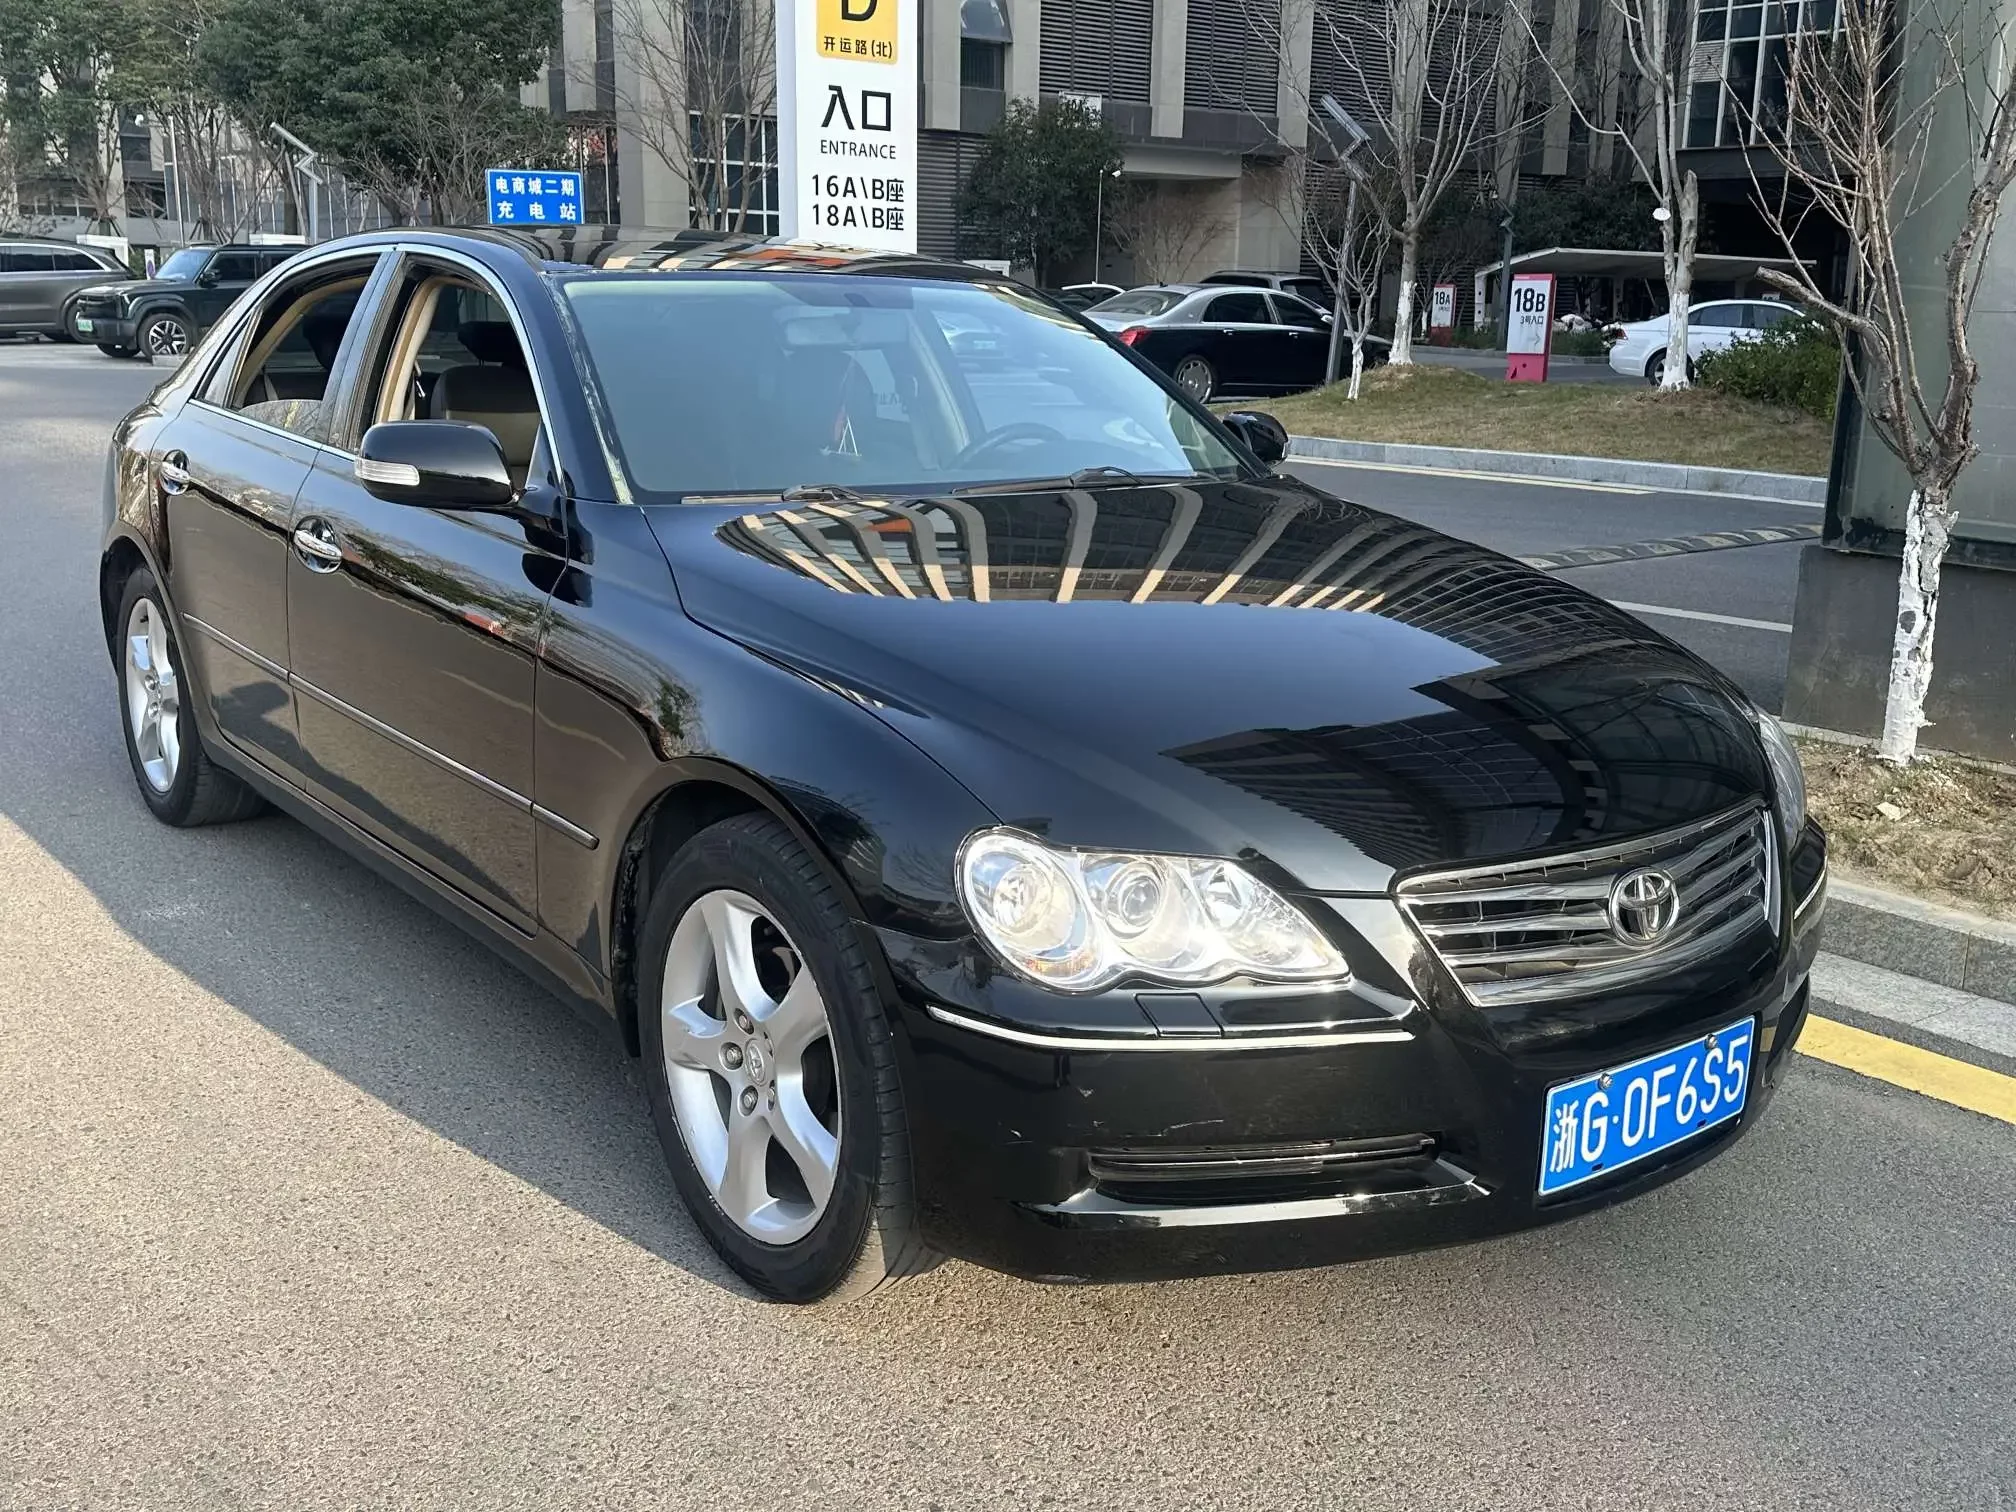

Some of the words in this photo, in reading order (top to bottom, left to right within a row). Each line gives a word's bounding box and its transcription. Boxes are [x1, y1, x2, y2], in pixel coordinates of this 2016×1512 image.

[824, 35, 893, 59] 开运路(北)
[821, 84, 892, 132] 入口
[820, 139, 897, 160] ENTRANCE
[495, 176, 575, 197] 电商城二期
[811, 173, 905, 203] 16A\B座
[811, 203, 905, 231] 18A\B座
[1434, 291, 1451, 305] 18A
[1514, 287, 1546, 313] 18B
